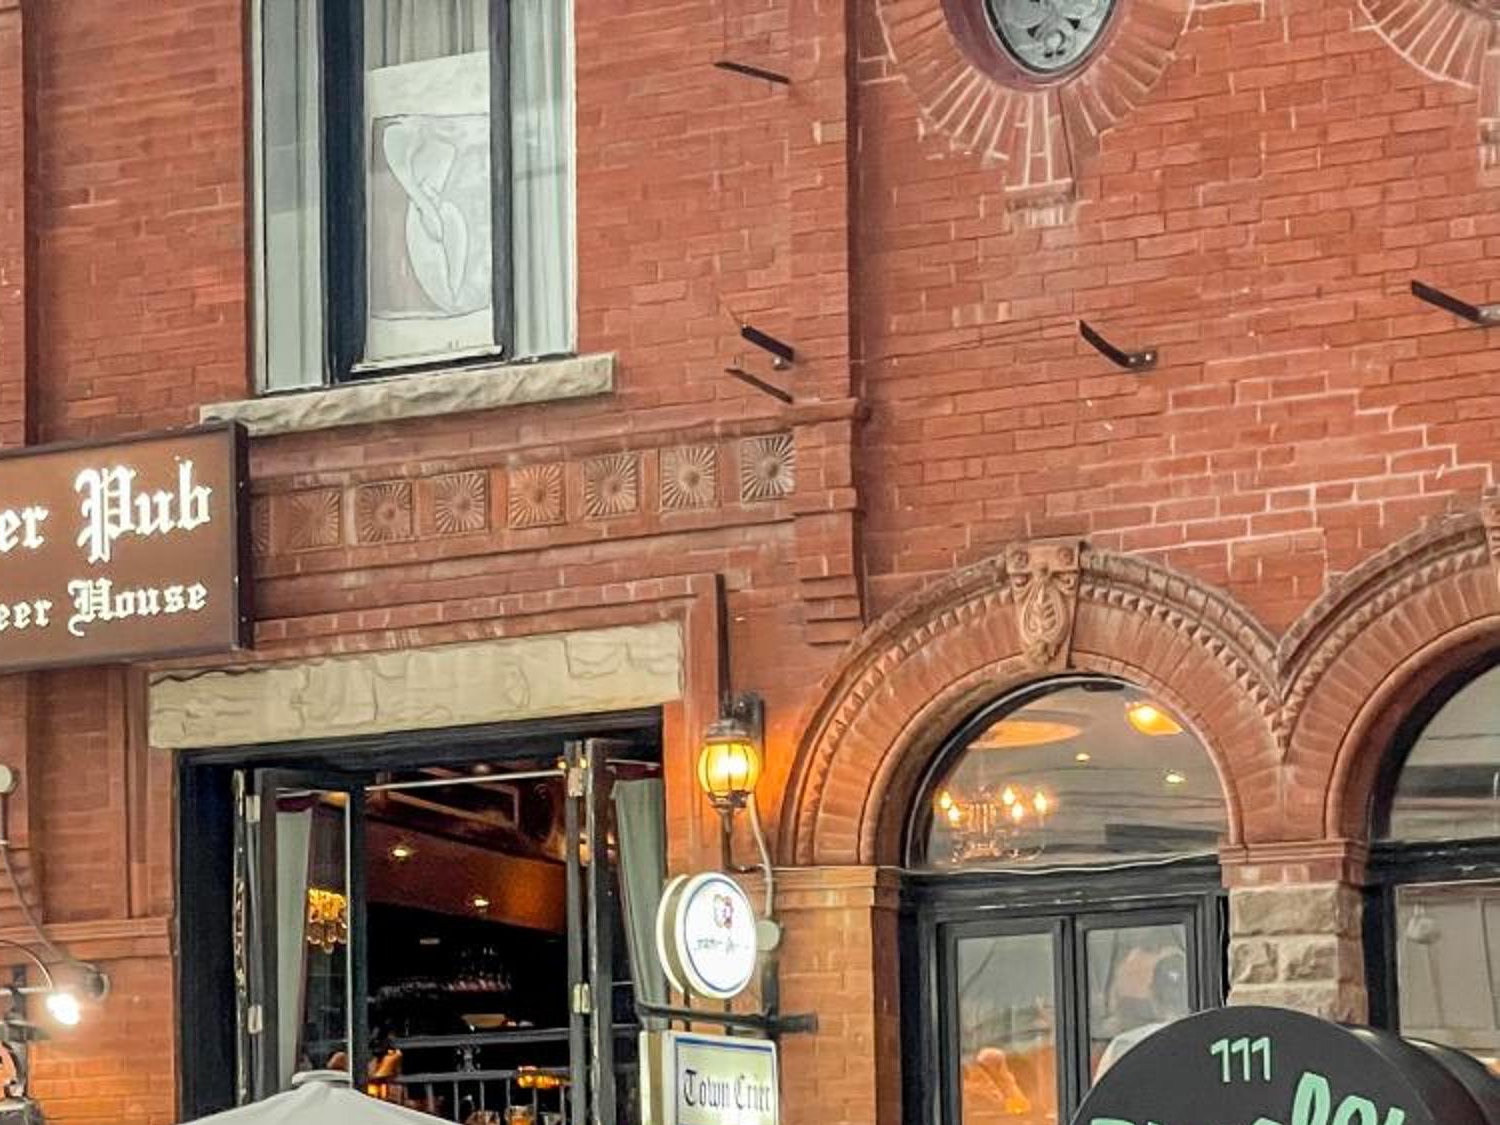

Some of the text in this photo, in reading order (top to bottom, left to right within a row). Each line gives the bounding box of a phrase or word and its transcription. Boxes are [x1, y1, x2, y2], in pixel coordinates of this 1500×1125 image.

[74, 457, 212, 564] Pub
[67, 577, 208, 637] House
[1210, 1036, 1271, 1083] 111
[683, 1068, 770, 1113] Town Crier
